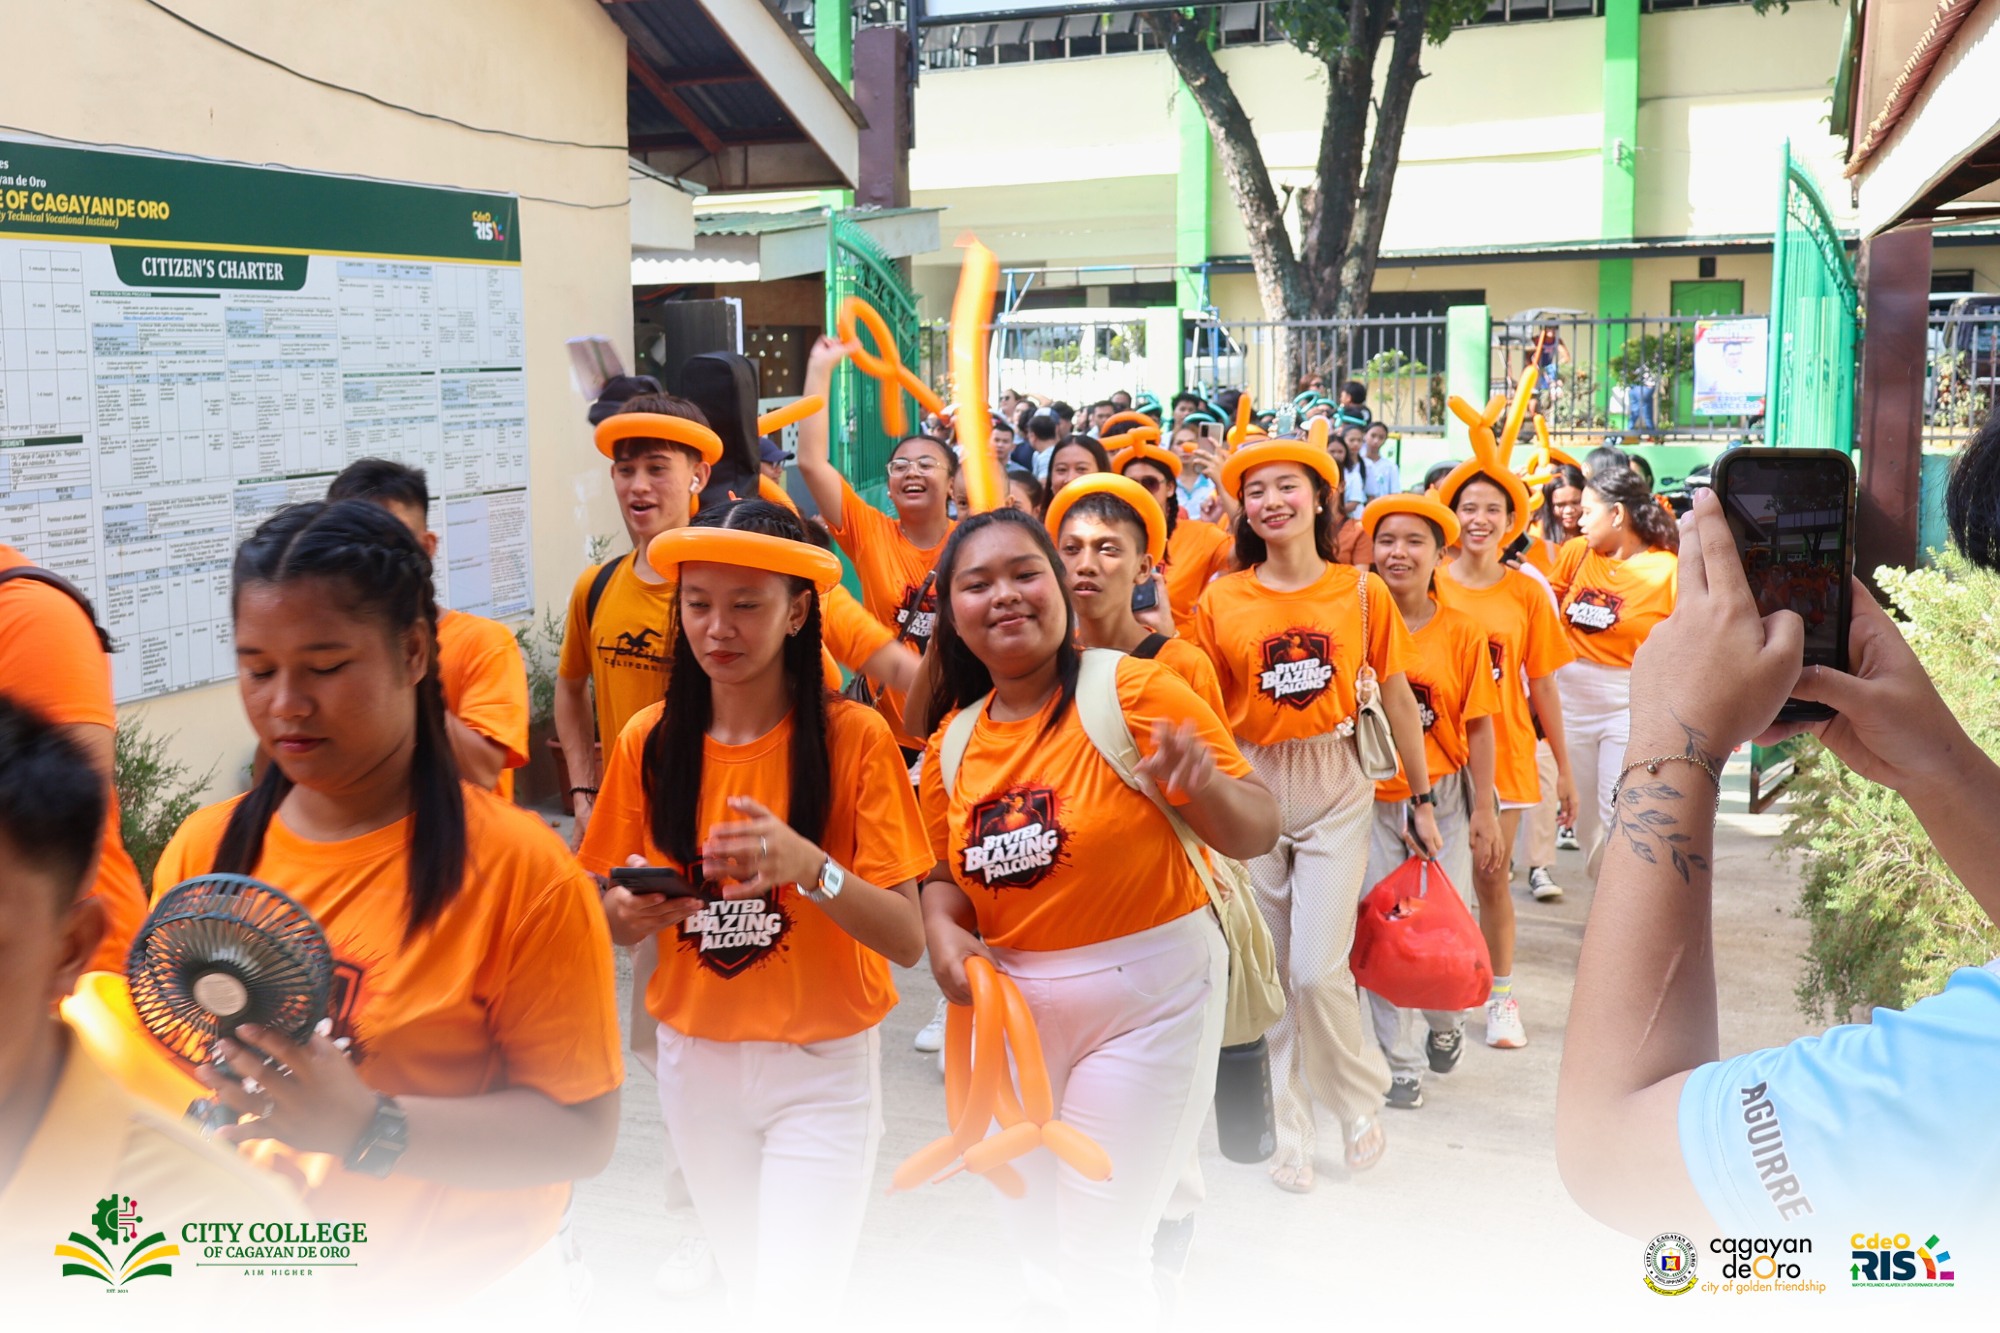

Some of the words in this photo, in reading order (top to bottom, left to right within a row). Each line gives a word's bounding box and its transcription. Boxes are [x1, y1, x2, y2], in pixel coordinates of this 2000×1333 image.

[16, 174, 27, 186] de
[29, 176, 46, 188] Oro
[6, 190, 28, 210] OF
[32, 192, 114, 216] CAGAYAN
[117, 198, 136, 218] DE
[138, 200, 170, 220] ORO
[8, 210, 44, 222] Technical
[46, 213, 84, 226] Vocational
[86, 216, 120, 230] Institute)
[142, 257, 215, 278] CITIZEN'S
[218, 260, 284, 281] CHARTER
[1260, 664, 1332, 690] BLAZING
[1275, 679, 1326, 699] FALCONS
[982, 823, 1042, 850] BTVTED
[964, 830, 1058, 872] BLAZING
[983, 850, 1052, 884] FALCONS
[1741, 1081, 1814, 1222] AGUIRRE
